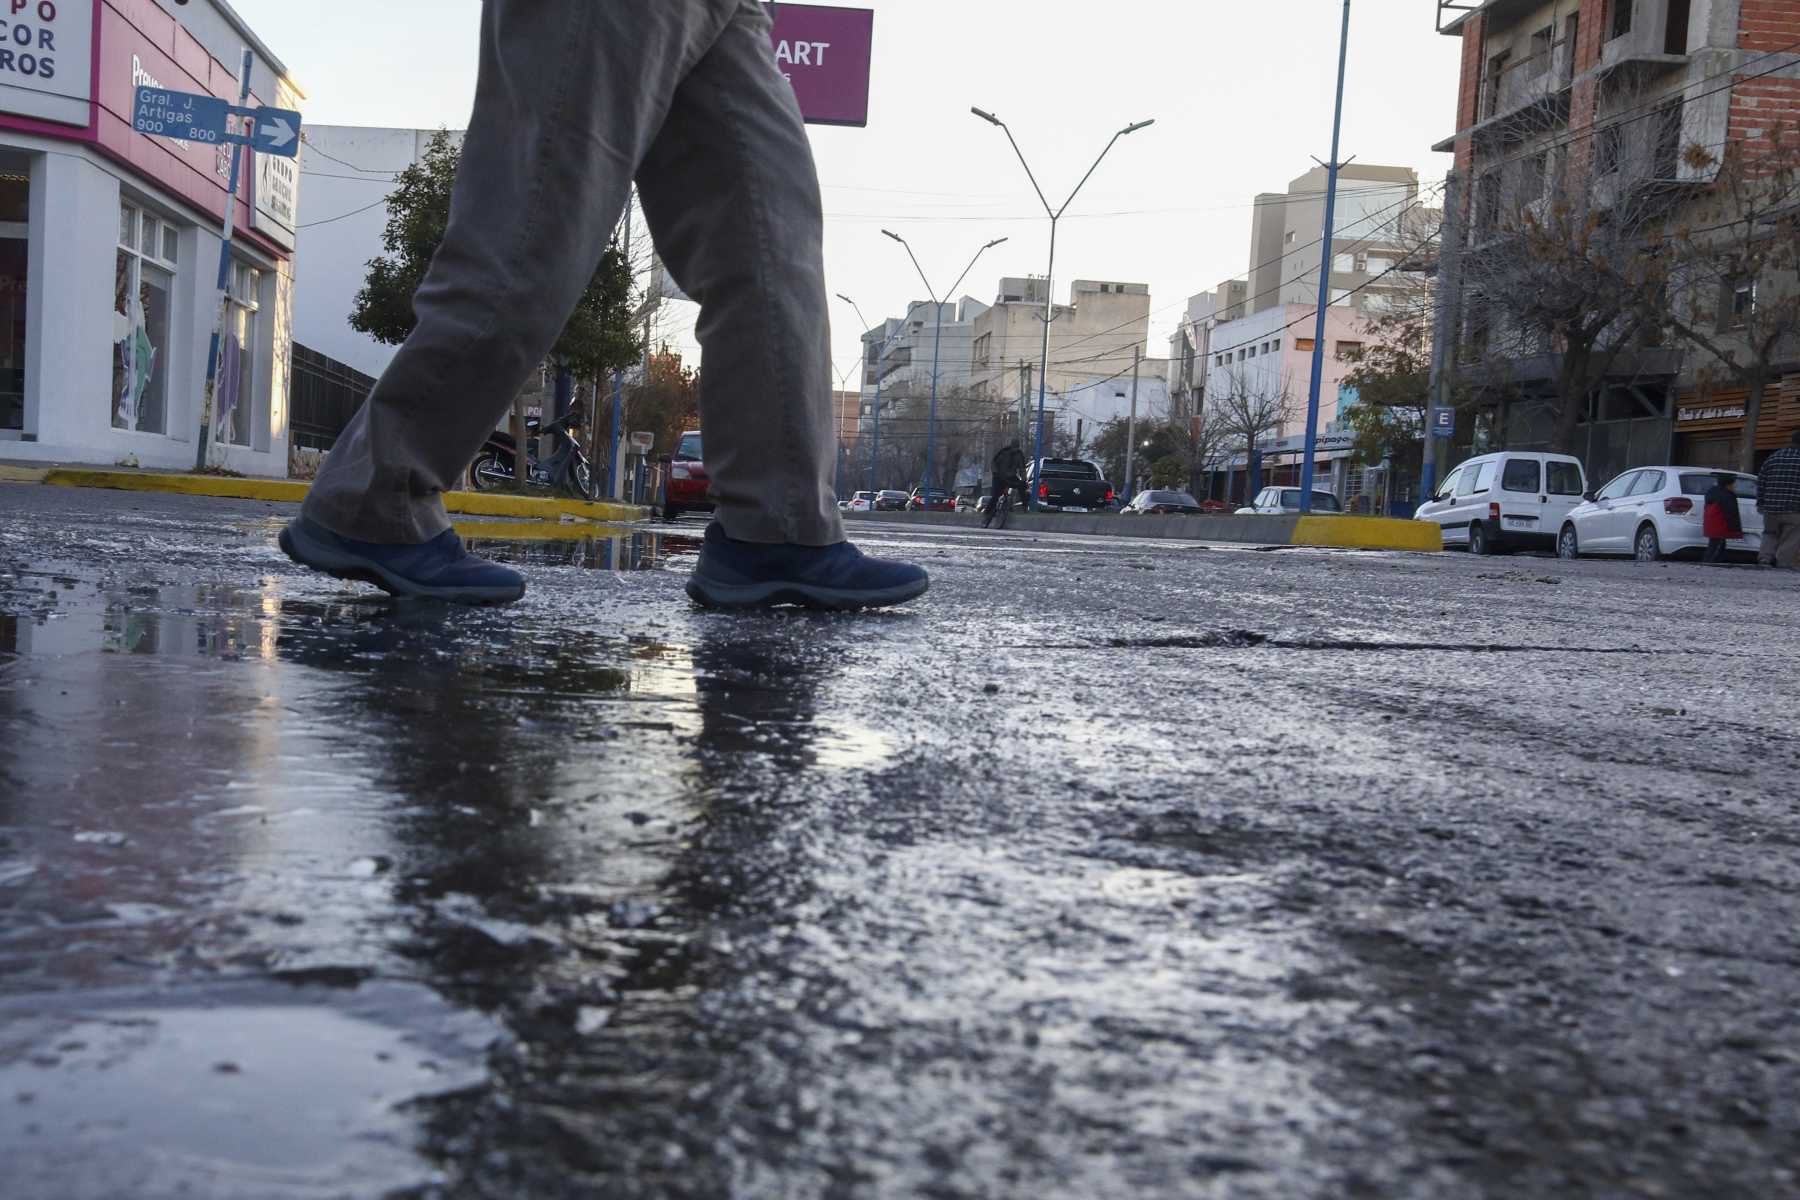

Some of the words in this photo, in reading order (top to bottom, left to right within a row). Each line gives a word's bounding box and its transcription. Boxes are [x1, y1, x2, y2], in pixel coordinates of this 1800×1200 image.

[0, 48, 55, 79] ROS
[140, 90, 173, 107] Gral.
[138, 103, 193, 124] Artigas
[137, 118, 164, 133] 900
[189, 127, 216, 141] 800
[1440, 412, 1449, 425] E
